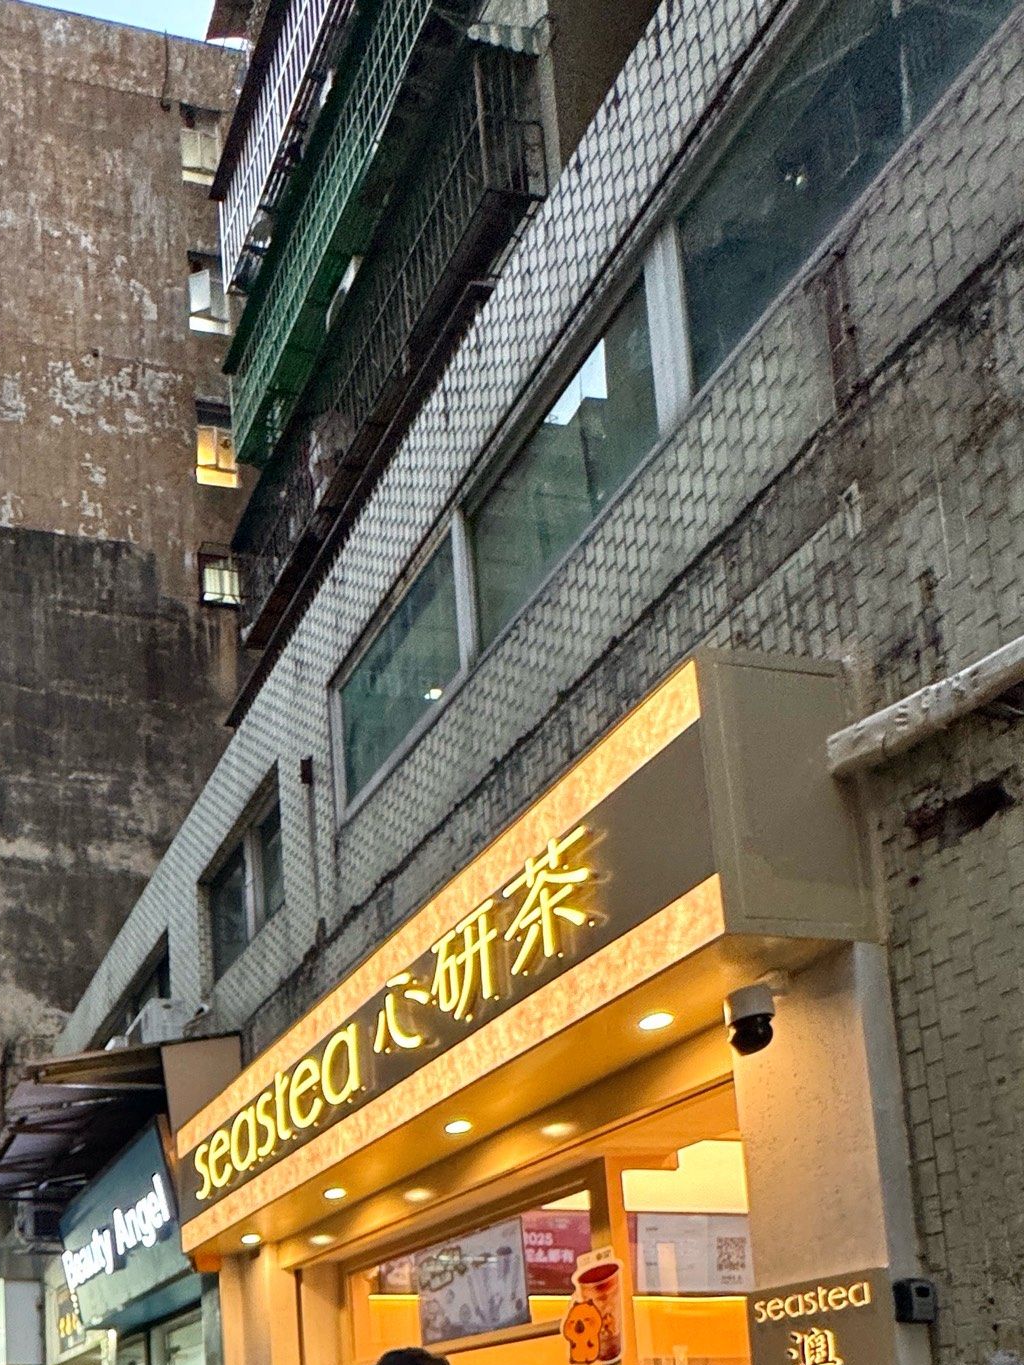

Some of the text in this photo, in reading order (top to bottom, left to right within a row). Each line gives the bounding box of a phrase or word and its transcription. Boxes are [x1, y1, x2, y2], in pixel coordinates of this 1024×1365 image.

[194, 824, 591, 1200] seastea 心研茶
[61, 1171, 171, 1292] Beauty Angel
[754, 1281, 872, 1324] seastea
